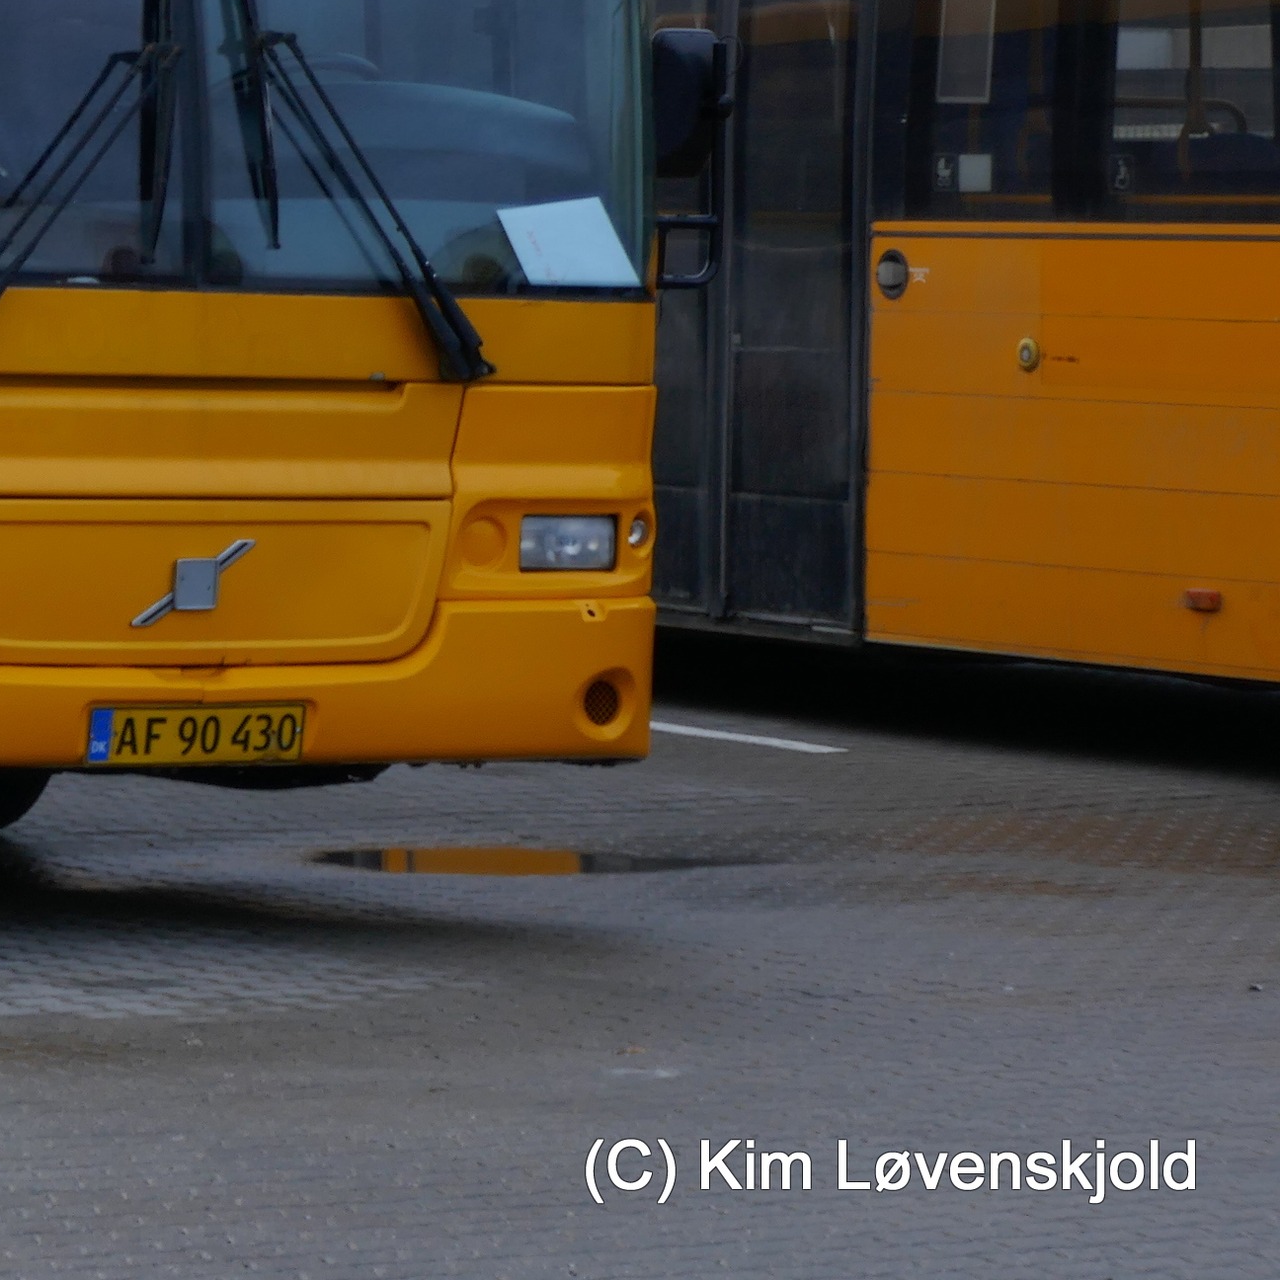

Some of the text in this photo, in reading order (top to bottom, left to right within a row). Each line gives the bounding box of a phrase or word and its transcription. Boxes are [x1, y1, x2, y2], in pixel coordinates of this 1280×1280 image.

[115, 713, 297, 756] AF 90 430
